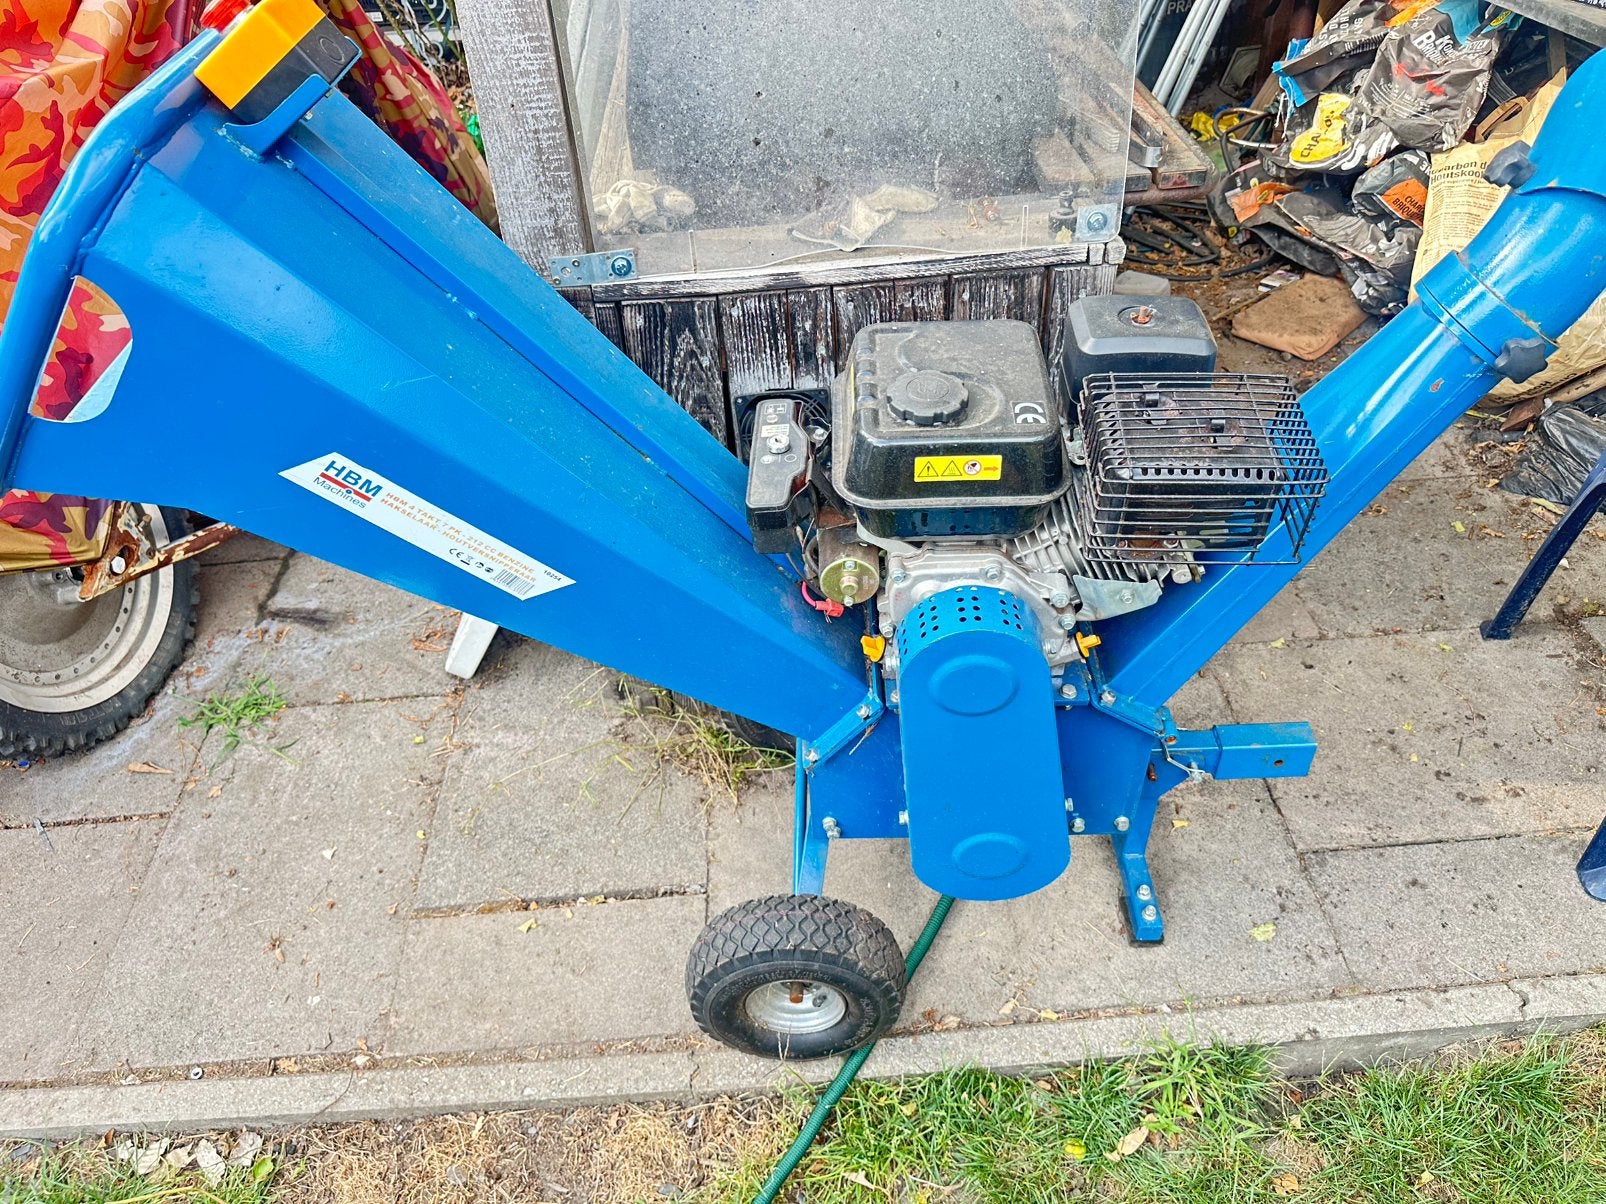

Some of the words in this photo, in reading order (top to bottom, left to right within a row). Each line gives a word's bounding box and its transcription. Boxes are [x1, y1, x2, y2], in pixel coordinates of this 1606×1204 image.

[313, 477, 367, 509] Machines
[324, 460, 383, 497] HBM
[380, 498, 437, 530] HAKSELAAR
[442, 530, 537, 583] HOUTVERSNIPPERAAR
[386, 492, 408, 507] HBM
[417, 508, 441, 523] TAKT
[449, 526, 462, 535] PK
[467, 535, 484, 547] 212
[484, 544, 497, 554] CC
[497, 551, 535, 574] BENZINE
